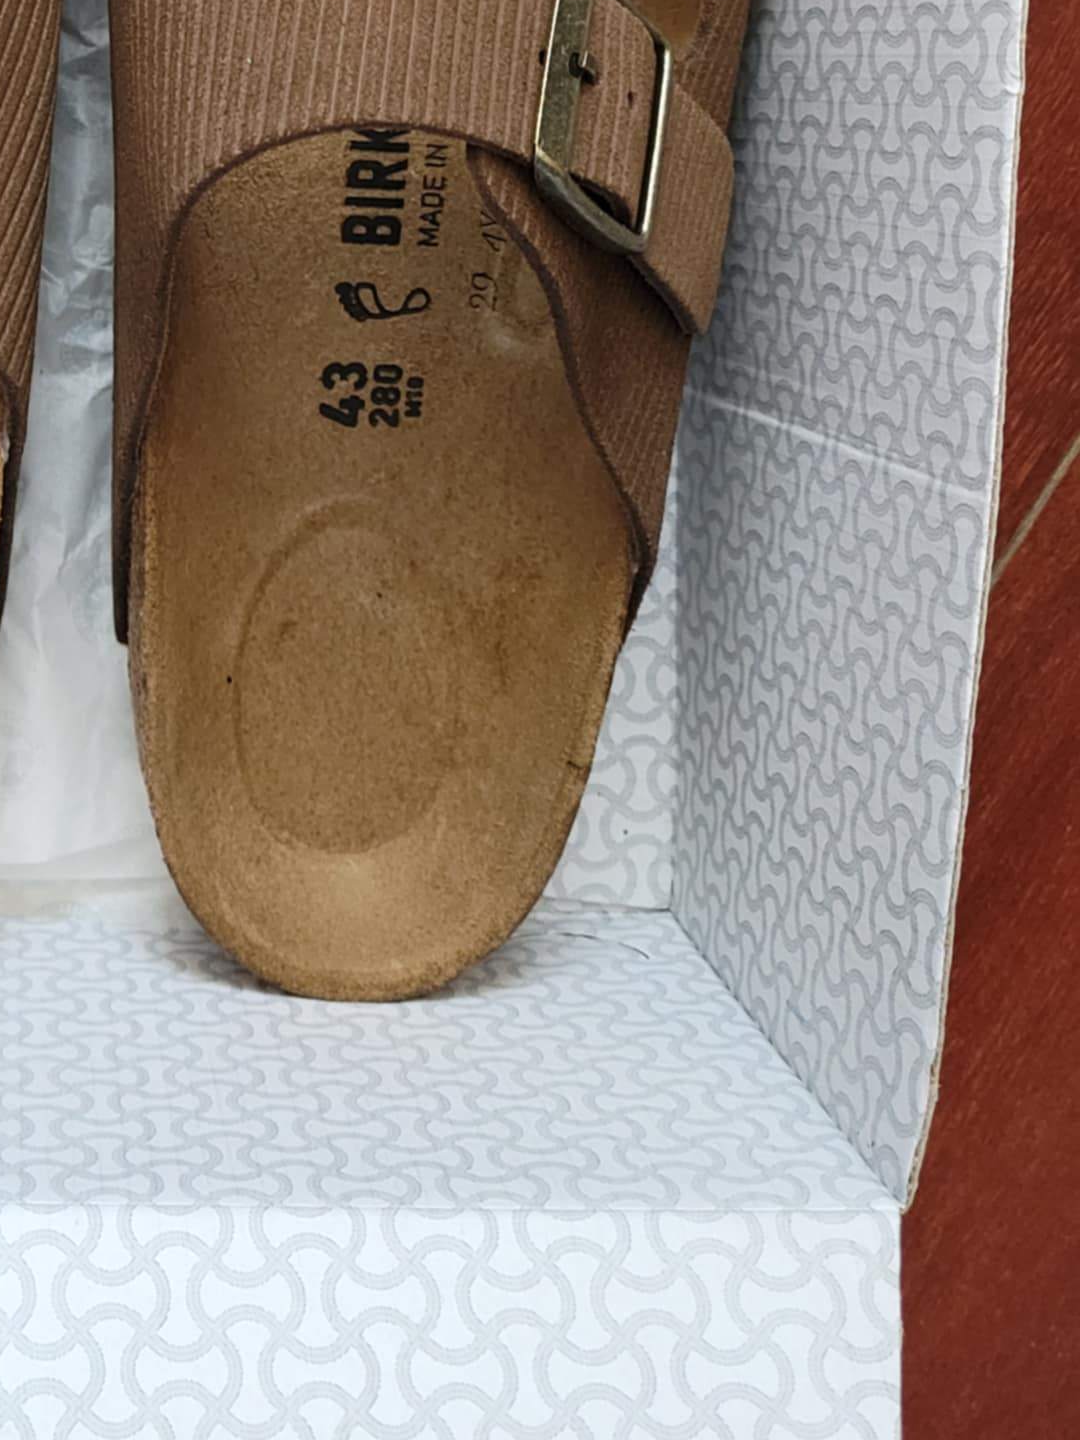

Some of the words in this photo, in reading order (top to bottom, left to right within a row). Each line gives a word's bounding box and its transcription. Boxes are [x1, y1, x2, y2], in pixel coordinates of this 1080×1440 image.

[424, 144, 449, 169] IN
[416, 175, 447, 248] MADE
[468, 271, 498, 312] 29
[319, 362, 368, 429] 43
[368, 363, 403, 428] 280
